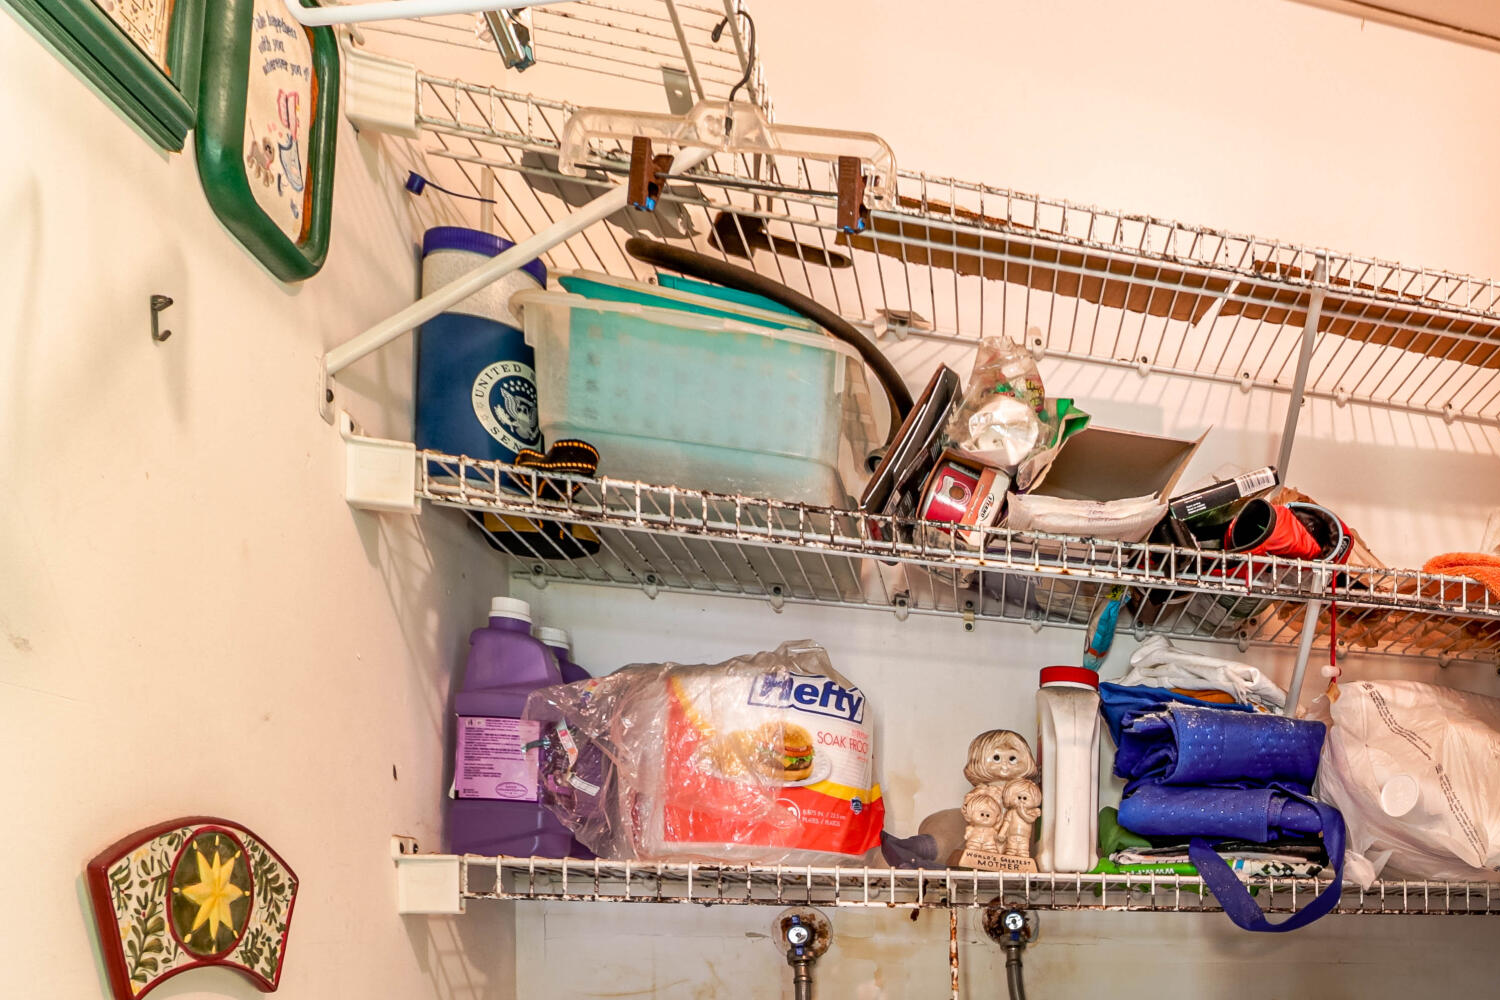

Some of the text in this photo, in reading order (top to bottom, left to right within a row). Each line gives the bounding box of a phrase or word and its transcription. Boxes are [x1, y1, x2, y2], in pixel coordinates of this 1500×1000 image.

[273, 39, 285, 53] you
[290, 63, 302, 77] you
[475, 363, 522, 398] UNITED
[760, 672, 863, 720] Hefty
[816, 731, 847, 749] SOAK
[977, 859, 1021, 871] MOTHER
